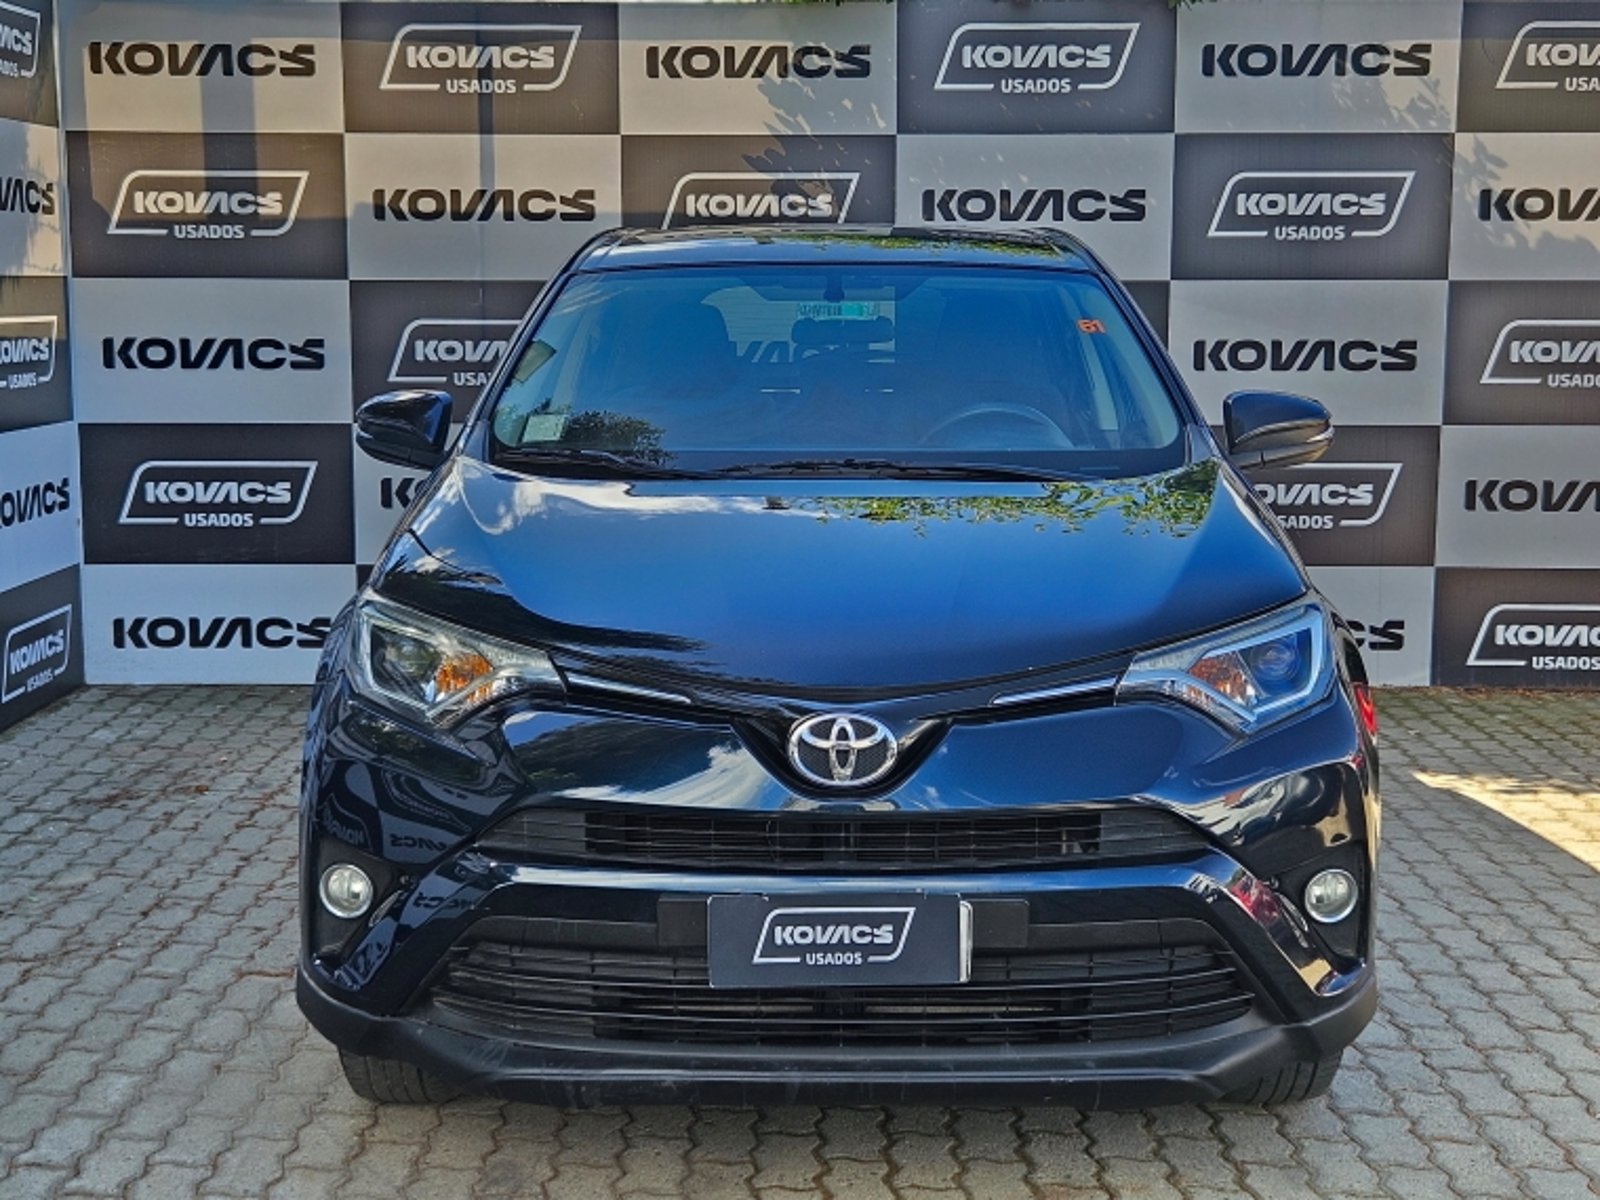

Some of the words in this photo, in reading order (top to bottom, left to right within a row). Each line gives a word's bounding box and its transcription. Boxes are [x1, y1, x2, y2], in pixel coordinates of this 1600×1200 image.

[89, 42, 315, 76] KOVACS
[406, 45, 555, 69] KOVACS
[646, 44, 871, 78] KOVACS
[962, 45, 1111, 68] KOVACS
[1202, 44, 1431, 76] KOVACS
[1526, 43, 1600, 66] KOV
[445, 78, 517, 94] USADOS
[1001, 78, 1071, 93] USADOS
[1565, 77, 1600, 91] USA
[0, 176, 55, 215] VACS
[134, 191, 283, 215] KOVACS
[374, 188, 596, 221] KOVACS
[686, 193, 833, 217] KOVACS
[922, 189, 1146, 221] KOVACS
[1237, 193, 1386, 216] KOVACS
[1478, 188, 1600, 221] KOV
[174, 224, 245, 239] USADOS
[1275, 226, 1345, 240] USADOS
[0, 337, 49, 364] OVACS
[103, 337, 325, 370] KOVACS
[414, 340, 509, 362] KOVA
[1194, 339, 1417, 371] KOVACS
[1510, 341, 1600, 363] KOVA
[453, 372, 491, 386] USA
[1547, 374, 1600, 388] USAD
[0, 478, 70, 528] OVACS
[145, 481, 291, 503] KOVACS
[1253, 484, 1374, 506] OVACS
[1465, 480, 1600, 511] KOVA
[184, 513, 254, 527] USADOS
[1278, 515, 1334, 529] SADOS
[113, 617, 331, 649] KOVACS
[1495, 624, 1600, 646] KOVA
[10, 629, 64, 674] KOVACS
[774, 926, 893, 945] KOVACS
[806, 952, 862, 965] USADOS
